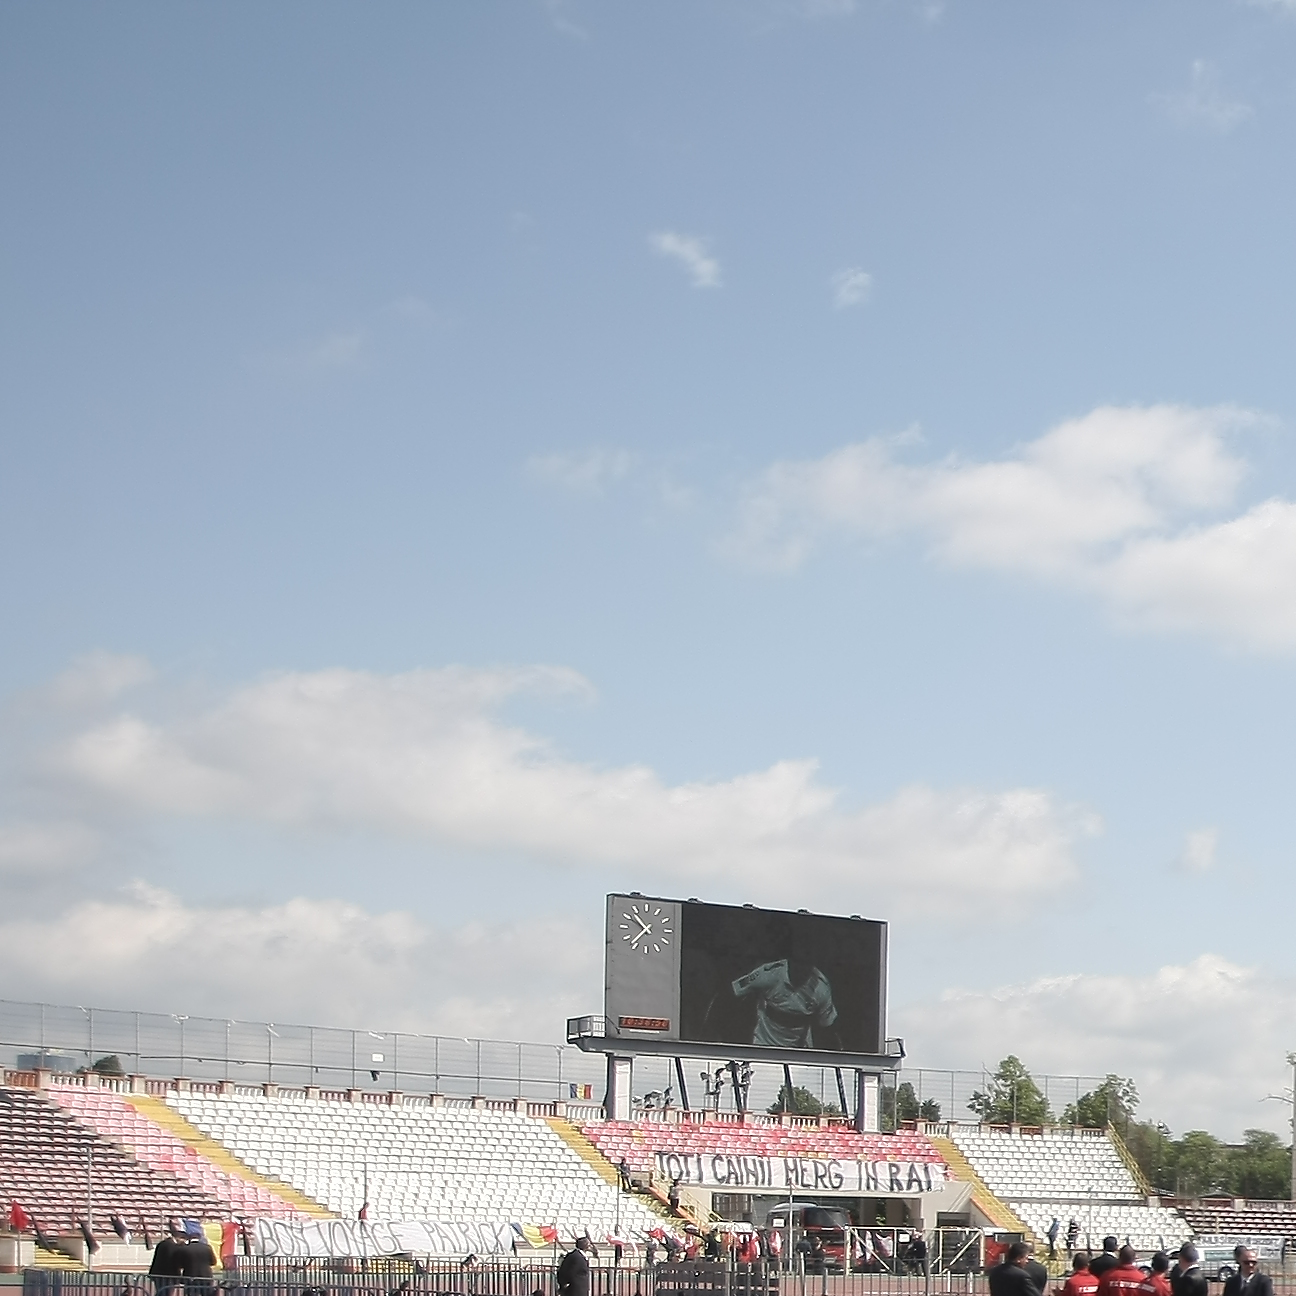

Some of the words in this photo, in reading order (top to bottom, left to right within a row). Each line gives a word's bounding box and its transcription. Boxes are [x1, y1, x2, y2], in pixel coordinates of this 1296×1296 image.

[784, 1158, 844, 1190] MERG
[889, 1162, 932, 1192] RAI
[316, 1219, 406, 1257] VOYAGE
[420, 1221, 506, 1255] PATRICK
